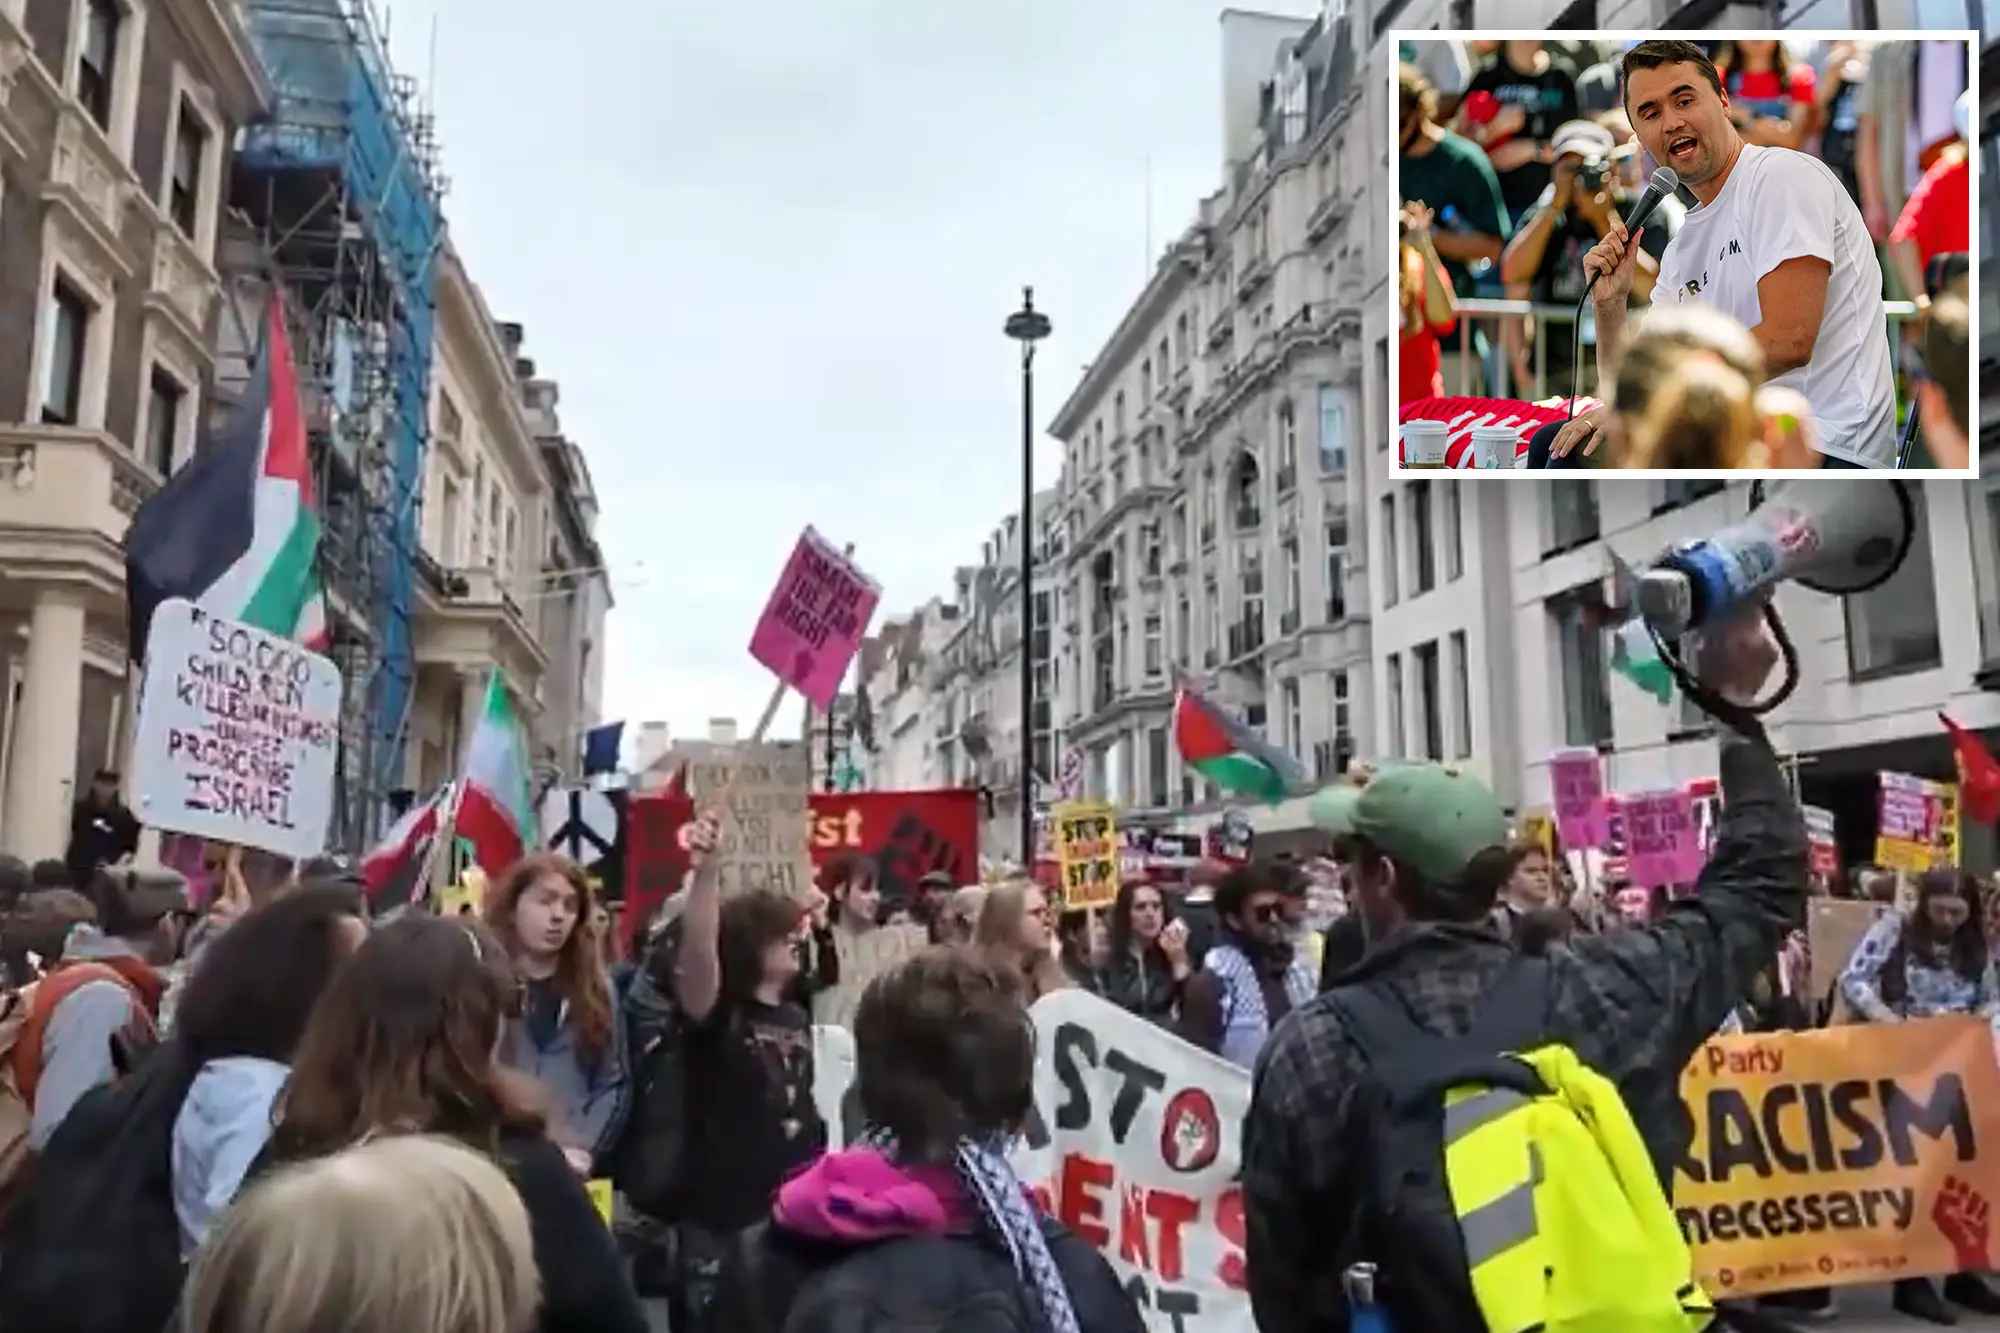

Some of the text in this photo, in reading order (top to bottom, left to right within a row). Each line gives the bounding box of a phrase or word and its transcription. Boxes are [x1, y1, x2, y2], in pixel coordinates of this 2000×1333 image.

[183, 772, 295, 830] ISRAEL
[1706, 1044, 1784, 1076] Party
[1675, 1186, 1914, 1245] necessary
